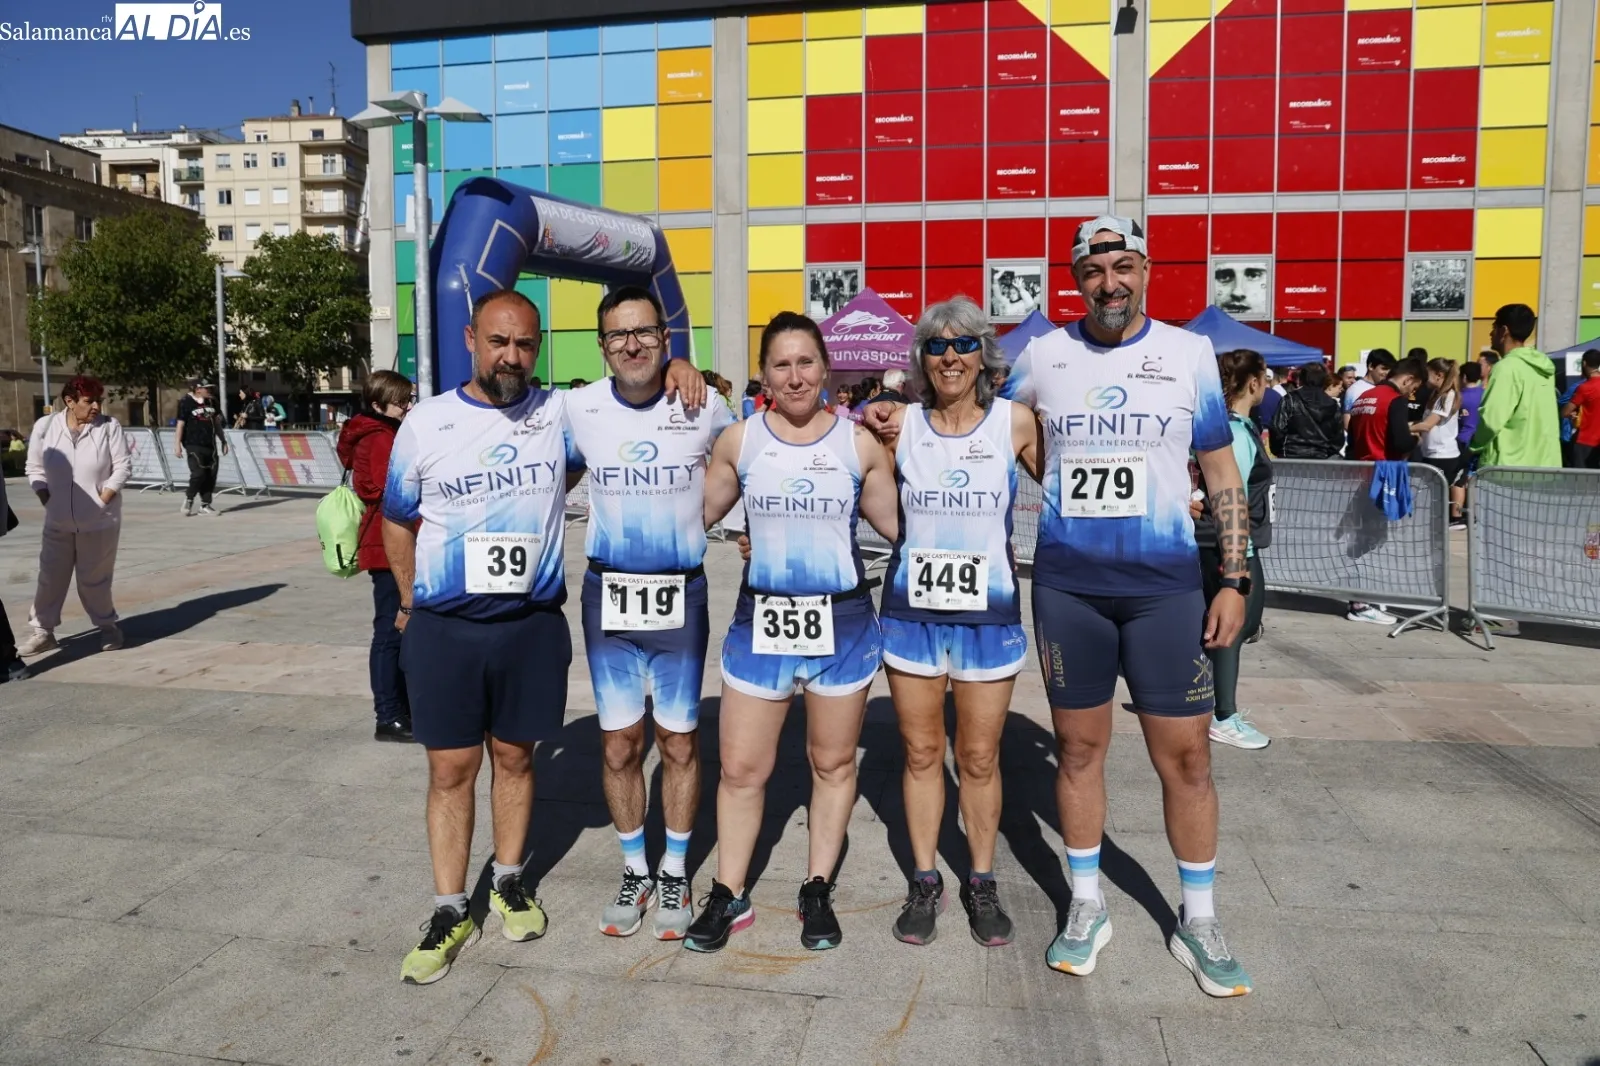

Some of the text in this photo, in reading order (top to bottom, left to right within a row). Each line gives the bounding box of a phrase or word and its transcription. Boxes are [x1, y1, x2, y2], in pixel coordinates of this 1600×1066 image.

[540, 203, 558, 218] DÍA
[560, 208, 576, 222] DE
[576, 211, 620, 231] CASTILLA
[627, 222, 652, 238] LEÓN
[1047, 414, 1172, 438] INFINITY
[1054, 438, 1162, 448] ASESORÍA ENERGÉTICA
[438, 460, 558, 500] INFINITY
[591, 464, 694, 486] NFINITY
[1071, 468, 1134, 500] 279
[500, 486, 554, 501] ENERGÉTICA
[636, 486, 692, 496] ENERGÉTICA
[748, 495, 848, 513] INFINITY
[906, 491, 1002, 508] INFINITY
[488, 545, 526, 577] 39
[918, 562, 977, 594] 449
[616, 586, 673, 616] 119
[763, 609, 822, 640] 358
[1050, 642, 1066, 688] LA LEGIÓN
